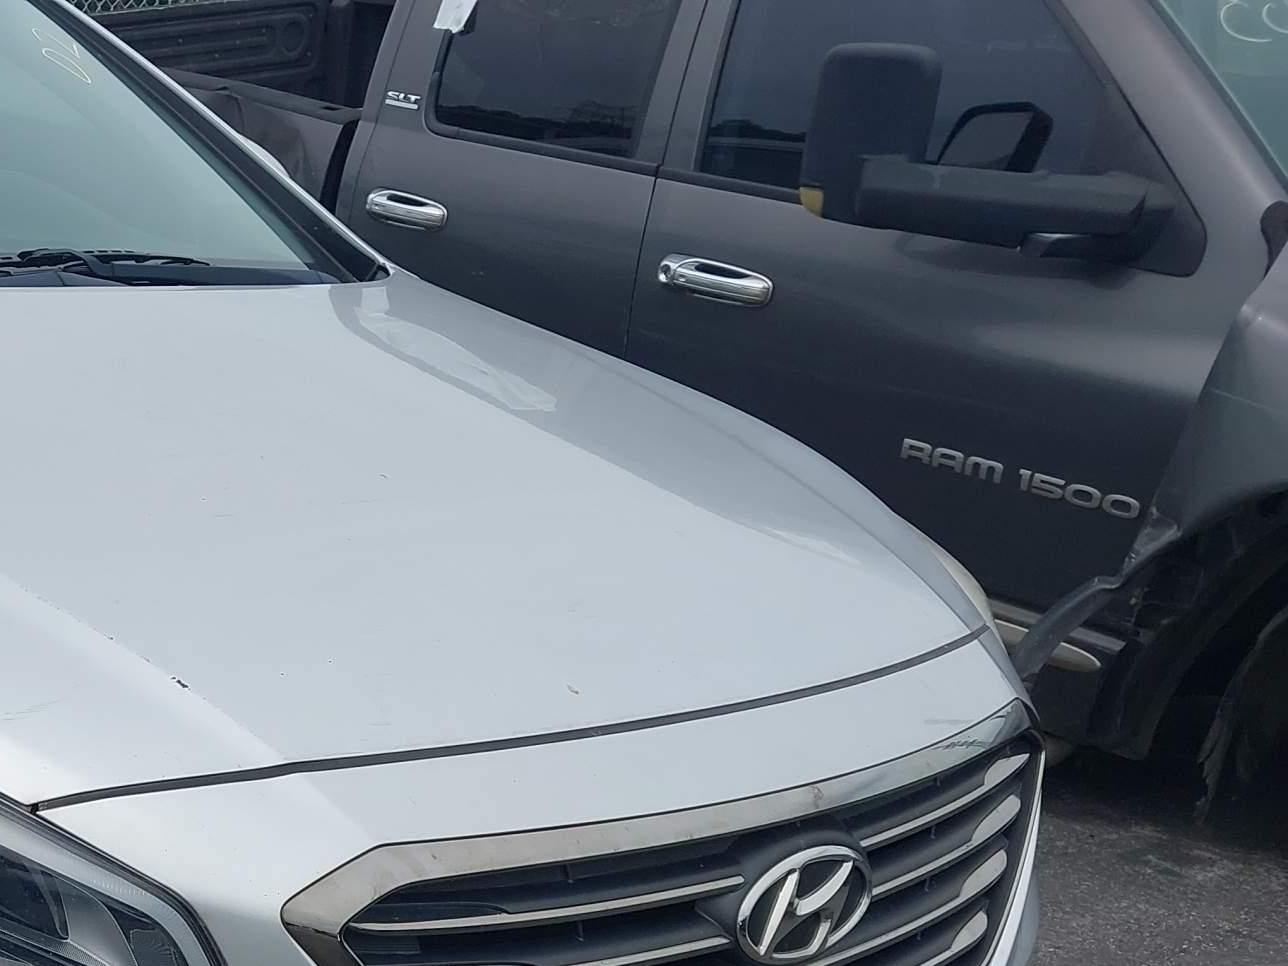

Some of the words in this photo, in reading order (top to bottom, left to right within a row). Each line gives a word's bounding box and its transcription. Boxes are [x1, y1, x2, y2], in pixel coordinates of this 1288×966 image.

[387, 91, 422, 103] SLT
[901, 438, 1004, 484] RAM
[1019, 468, 1141, 520] 1500
